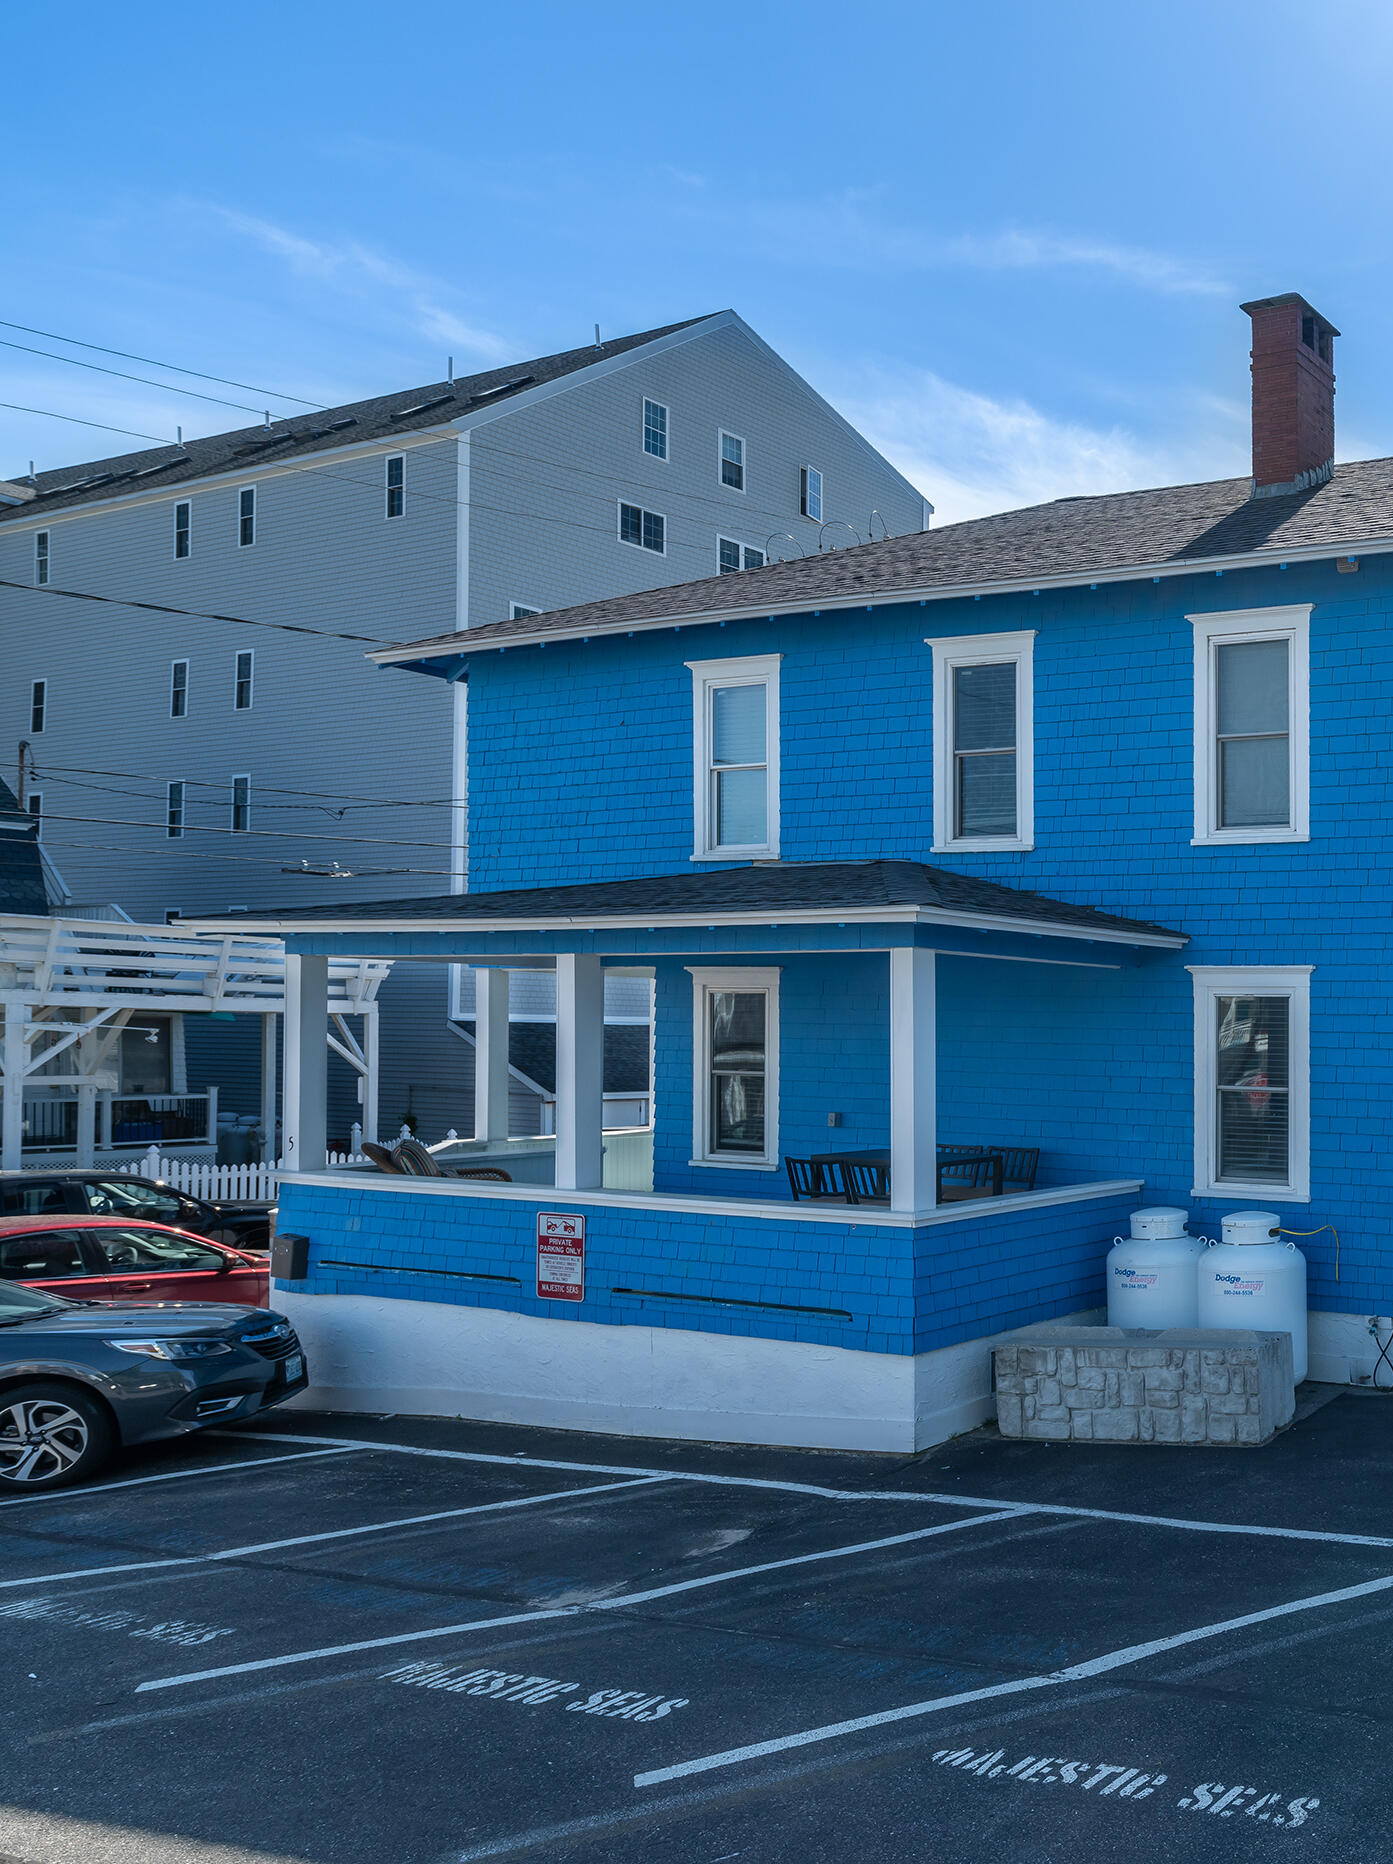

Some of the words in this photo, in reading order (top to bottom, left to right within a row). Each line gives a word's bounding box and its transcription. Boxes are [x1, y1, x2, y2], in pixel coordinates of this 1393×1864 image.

[288, 1135, 294, 1152] 5
[549, 1238, 572, 1246] PRIVATE
[540, 1245, 564, 1253] PARKING
[566, 1247, 581, 1255] ONLY
[1114, 1267, 1136, 1277] Dodge
[1129, 1275, 1158, 1284] Energy
[1215, 1274, 1241, 1284] Dodge
[541, 1284, 565, 1293] MAJESTIC
[566, 1286, 579, 1294] SEAS
[1233, 1282, 1264, 1291] Energy
[376, 1661, 580, 1704] MAJESTIC
[565, 1689, 689, 1722] SEAS
[932, 1747, 1168, 1800] MAJESTIC
